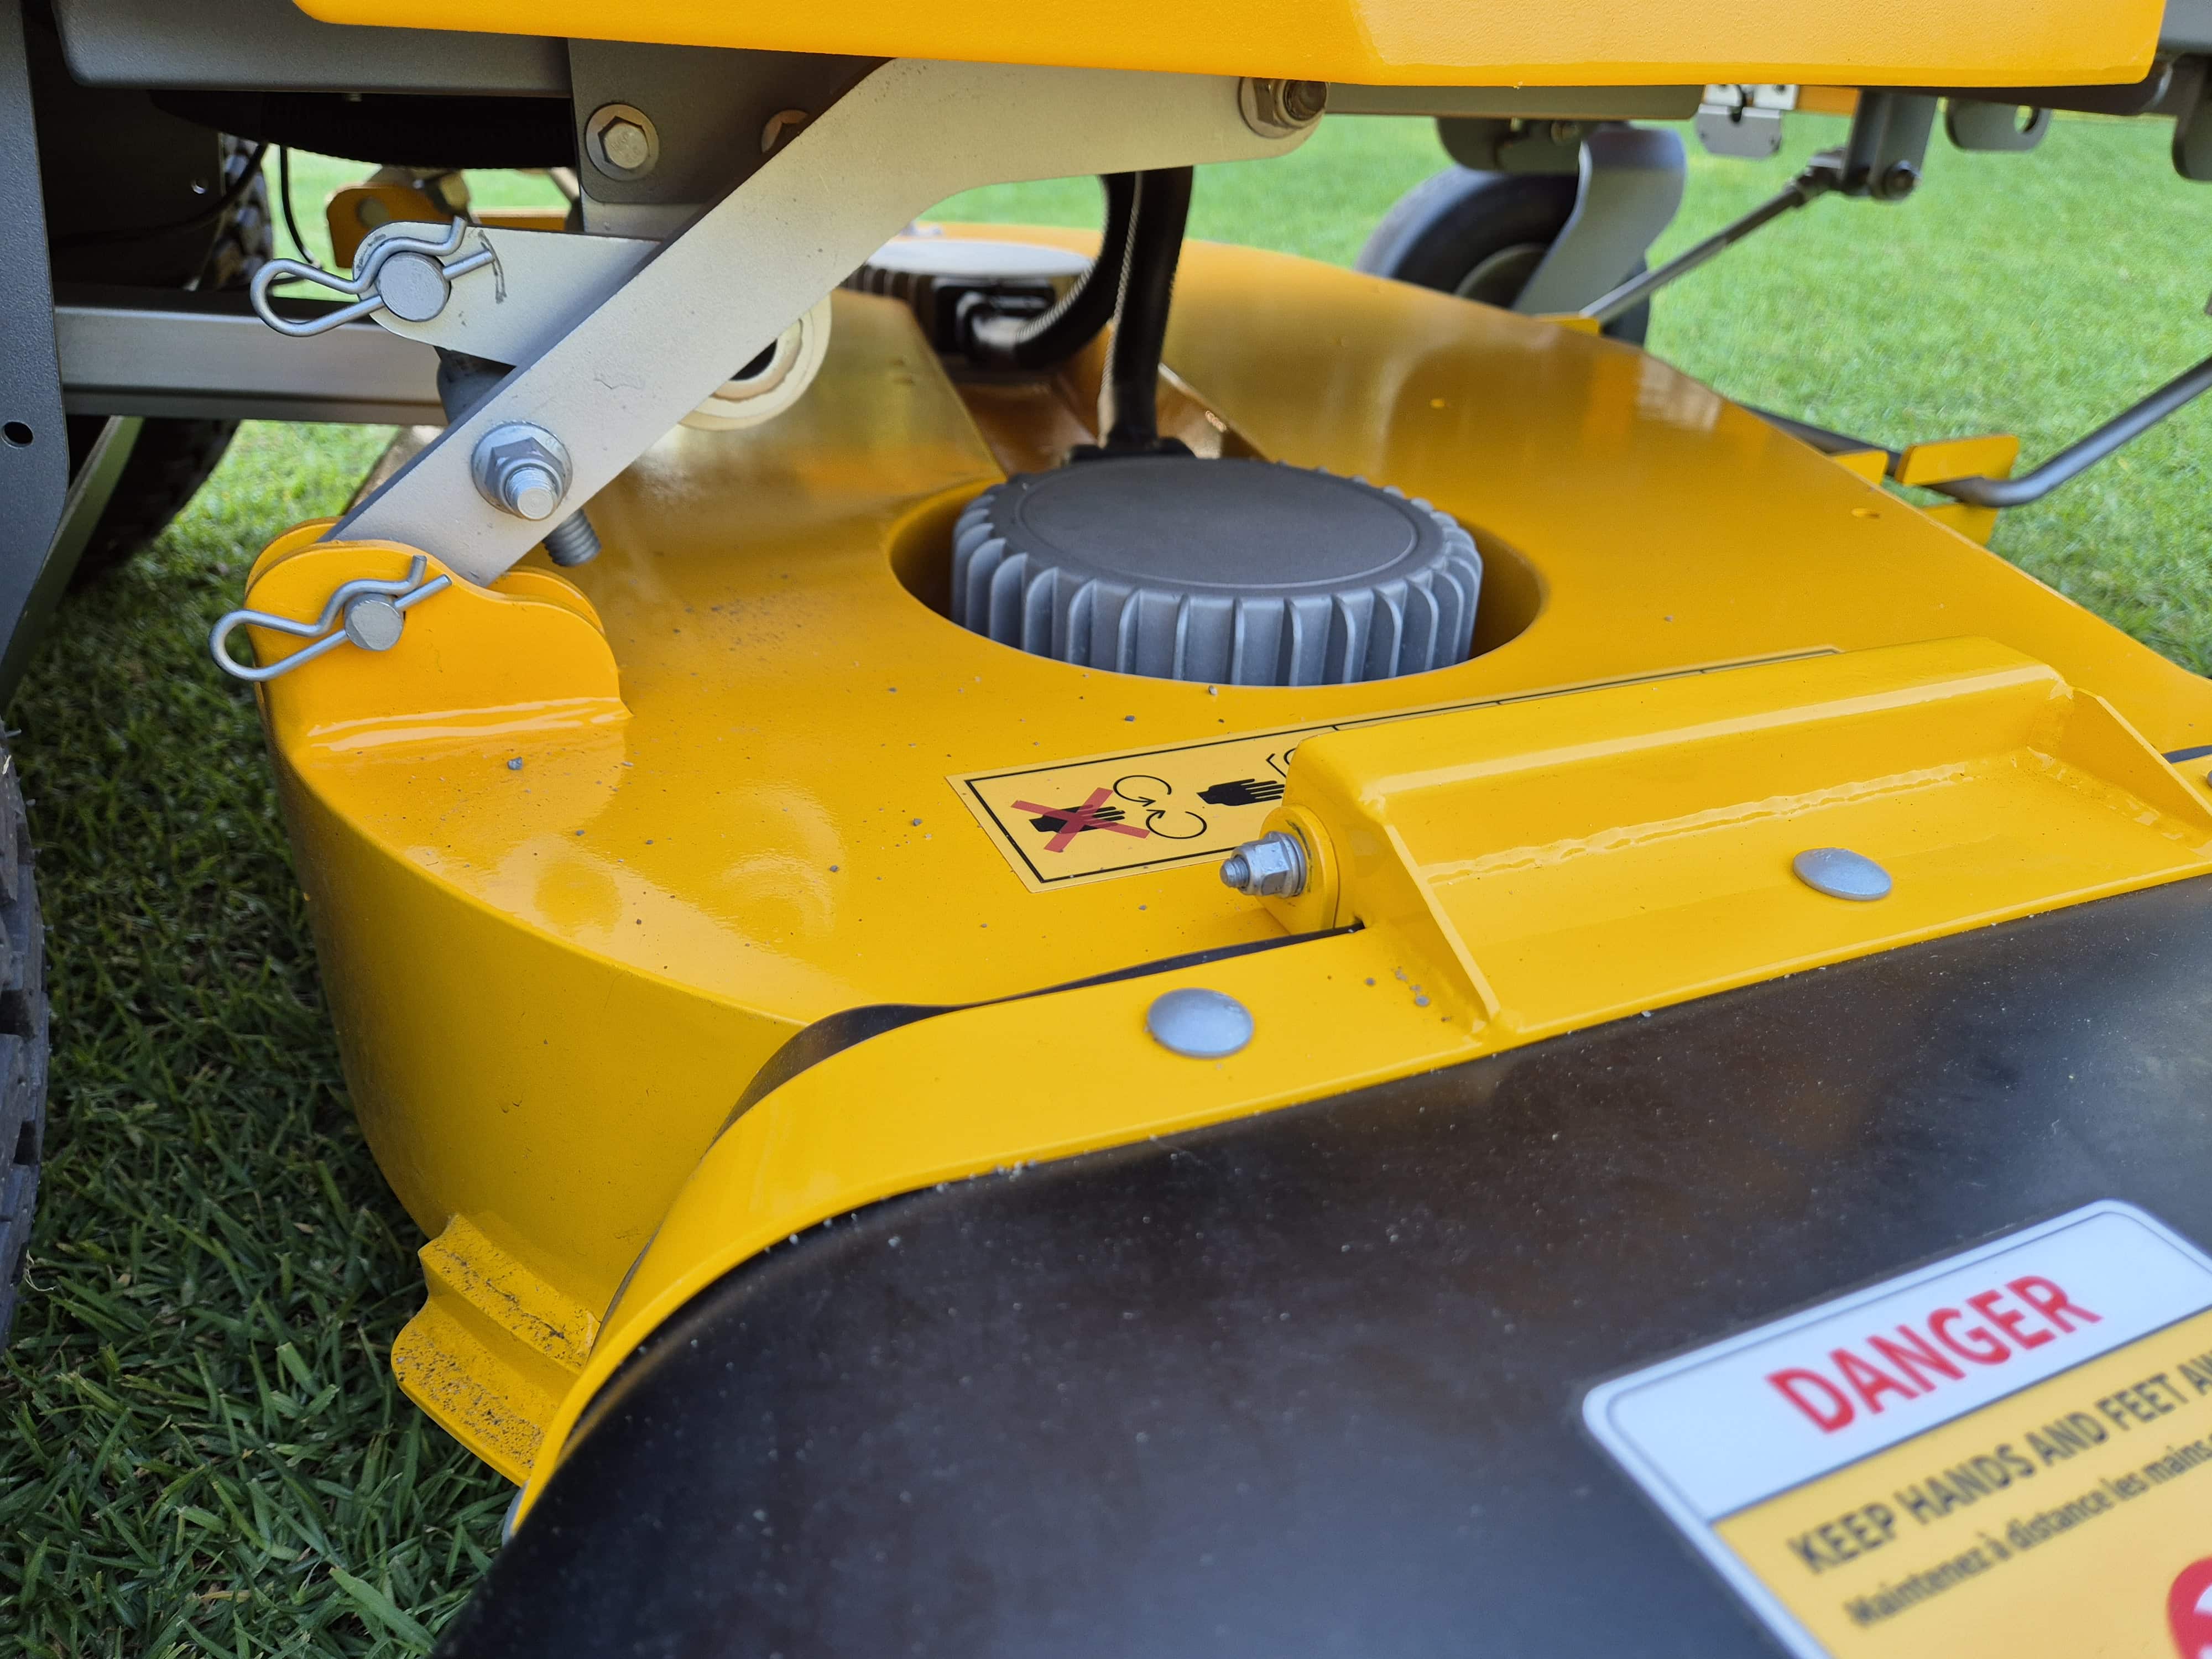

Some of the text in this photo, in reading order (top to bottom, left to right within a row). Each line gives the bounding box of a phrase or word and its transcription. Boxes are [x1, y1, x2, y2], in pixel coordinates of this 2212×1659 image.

[1766, 1275, 2103, 1433] DANGER
[1787, 1502, 1897, 1574] KEEP
[1893, 1444, 2036, 1525] HANDS
[2025, 1411, 2109, 1467] AND
[2095, 1373, 2189, 1431] FEET
[1843, 1547, 1994, 1629] Maintenez
[2006, 1490, 2115, 1551] distance
[2098, 1472, 2150, 1501] les
[2141, 1439, 2212, 1485] mains
